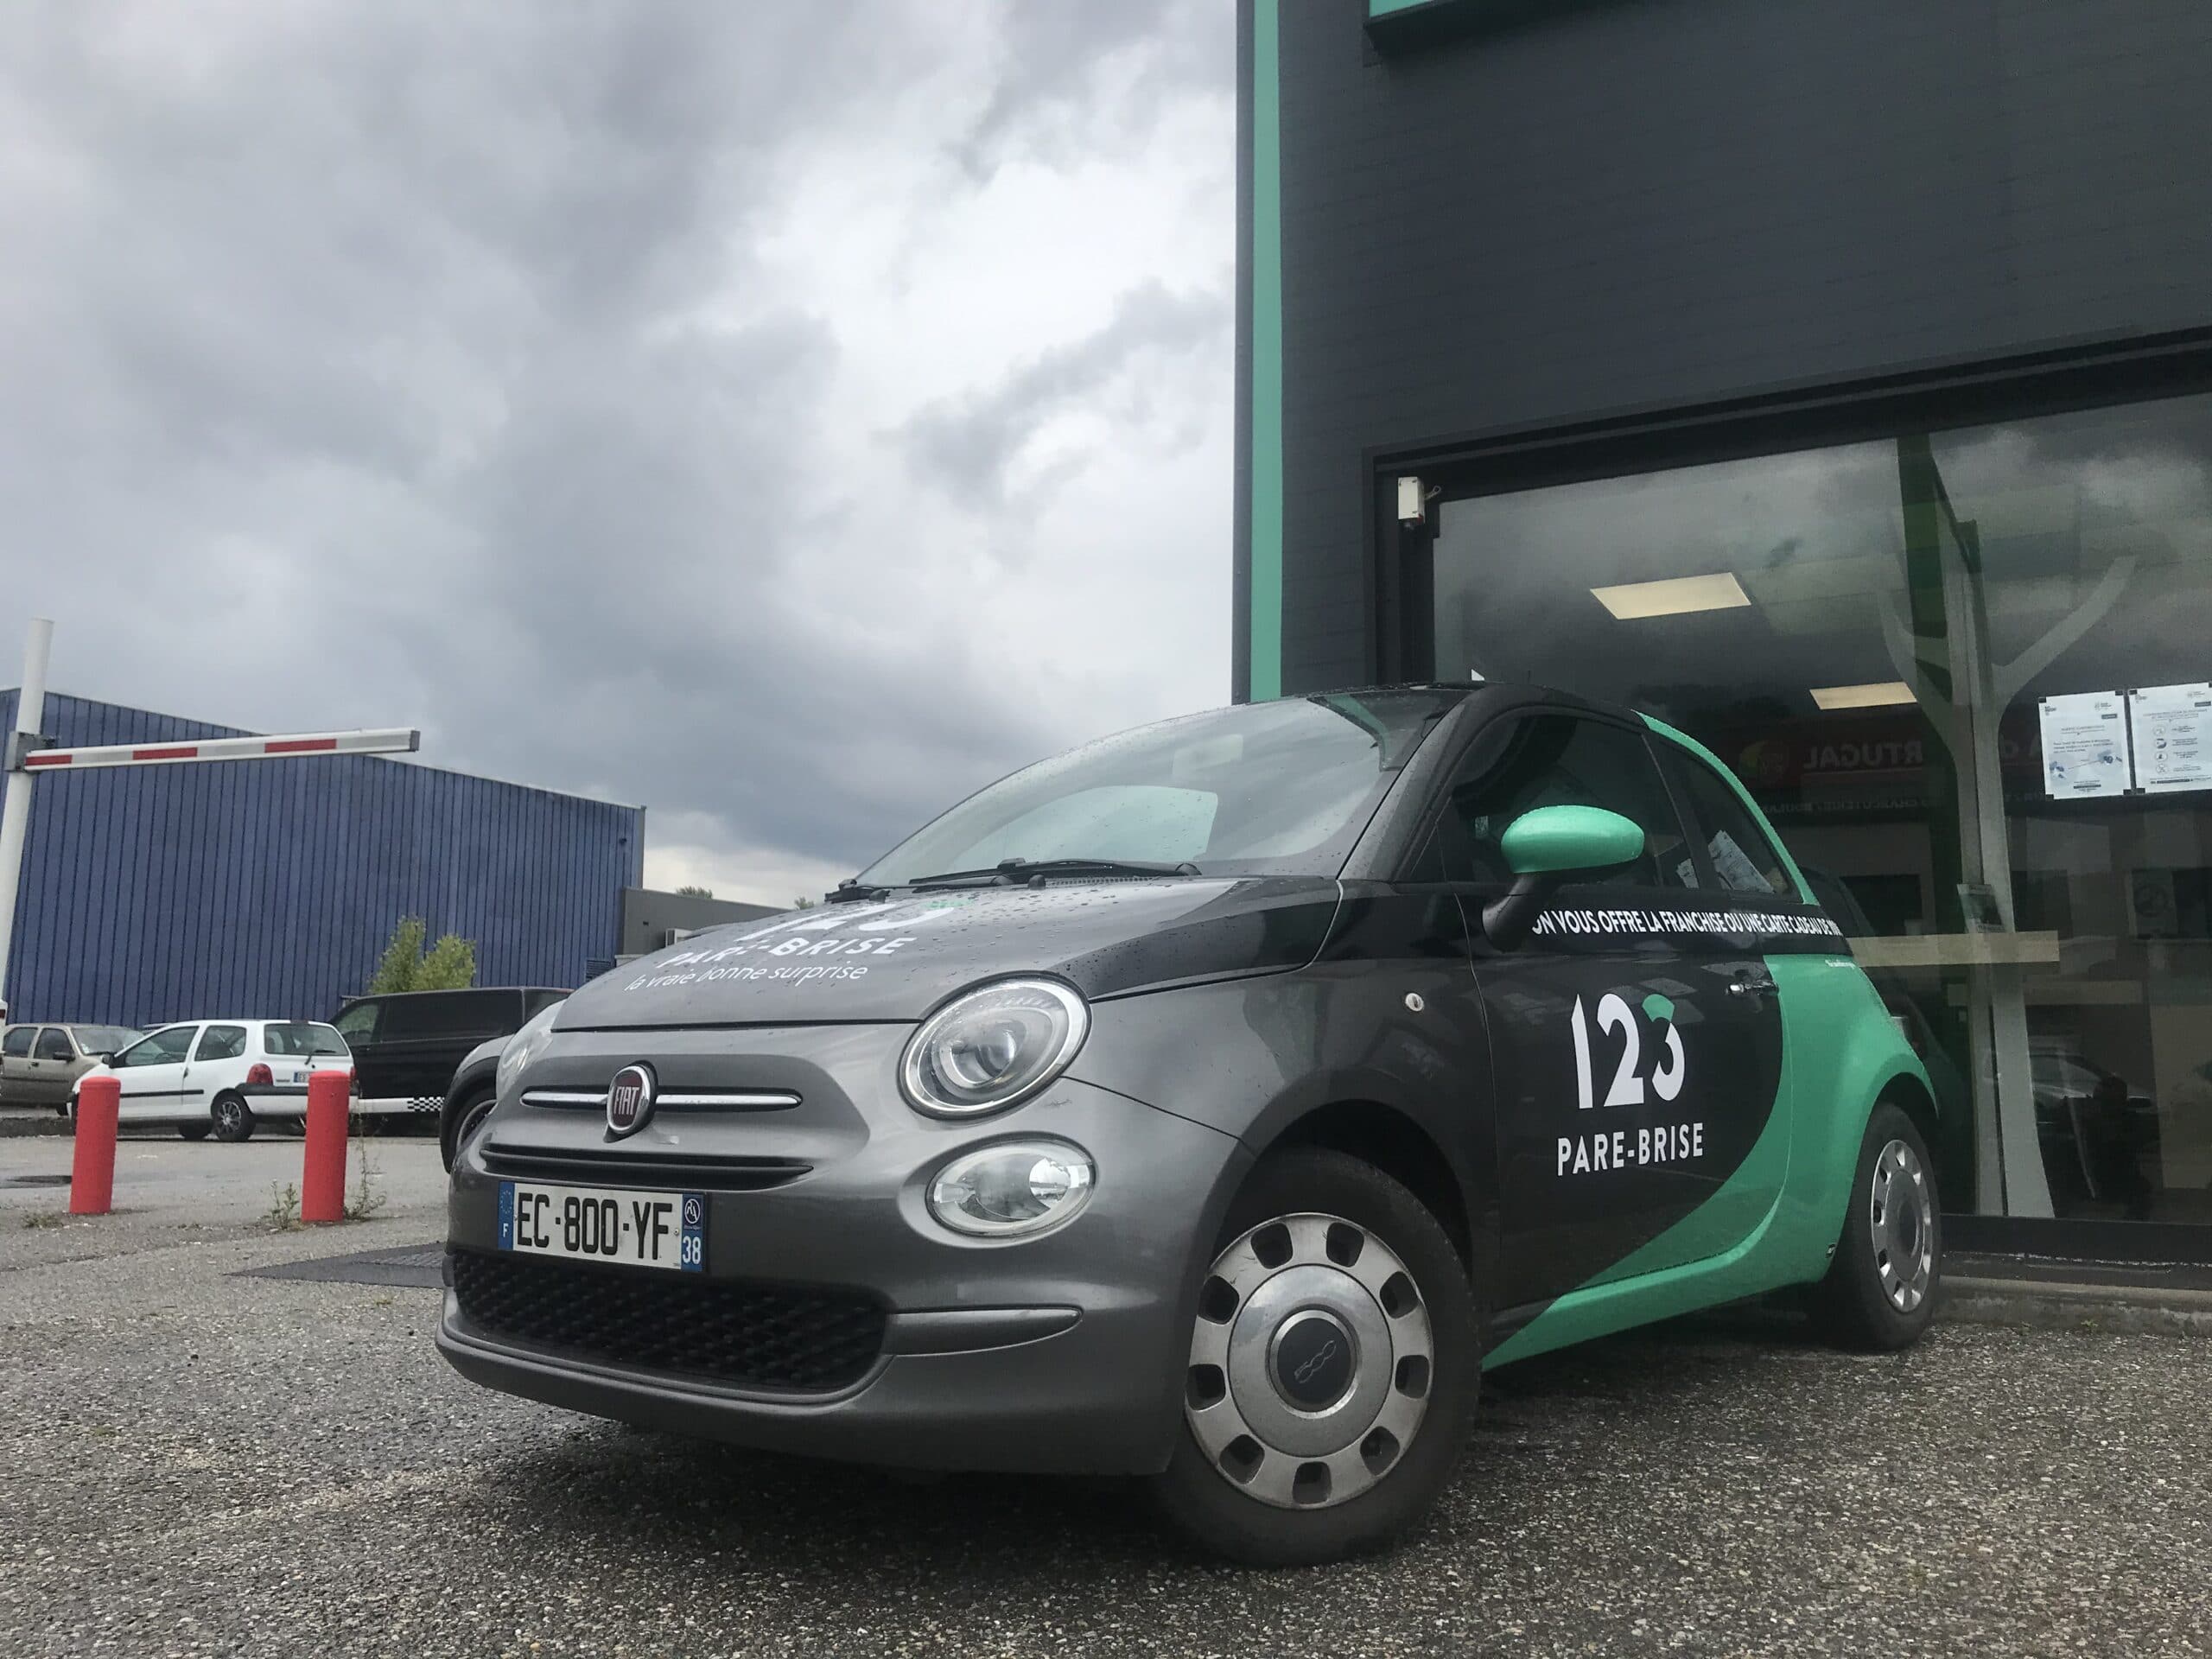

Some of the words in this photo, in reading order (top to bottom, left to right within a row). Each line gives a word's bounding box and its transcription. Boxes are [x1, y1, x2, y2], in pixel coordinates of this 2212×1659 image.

[1550, 910, 1600, 934] VOUS
[1597, 910, 1646, 933] OFFRE
[1641, 911, 1664, 933] LA
[1658, 911, 1729, 933] FRANCHISE
[1723, 912, 1744, 933] OU
[1738, 913, 1767, 933] UNE
[1759, 913, 1793, 934] CARTE
[1787, 915, 1823, 935] CADEAU
[624, 974, 647, 991] la
[645, 968, 697, 988] vraie
[695, 964, 768, 983] bonne
[767, 960, 868, 987] surprise
[1571, 993, 1685, 1109] 123
[613, 1086, 640, 1116] FIAT
[1557, 1122, 1704, 1176] PARE-BRISE
[503, 1223, 509, 1238] F
[682, 1235, 702, 1265] 38
